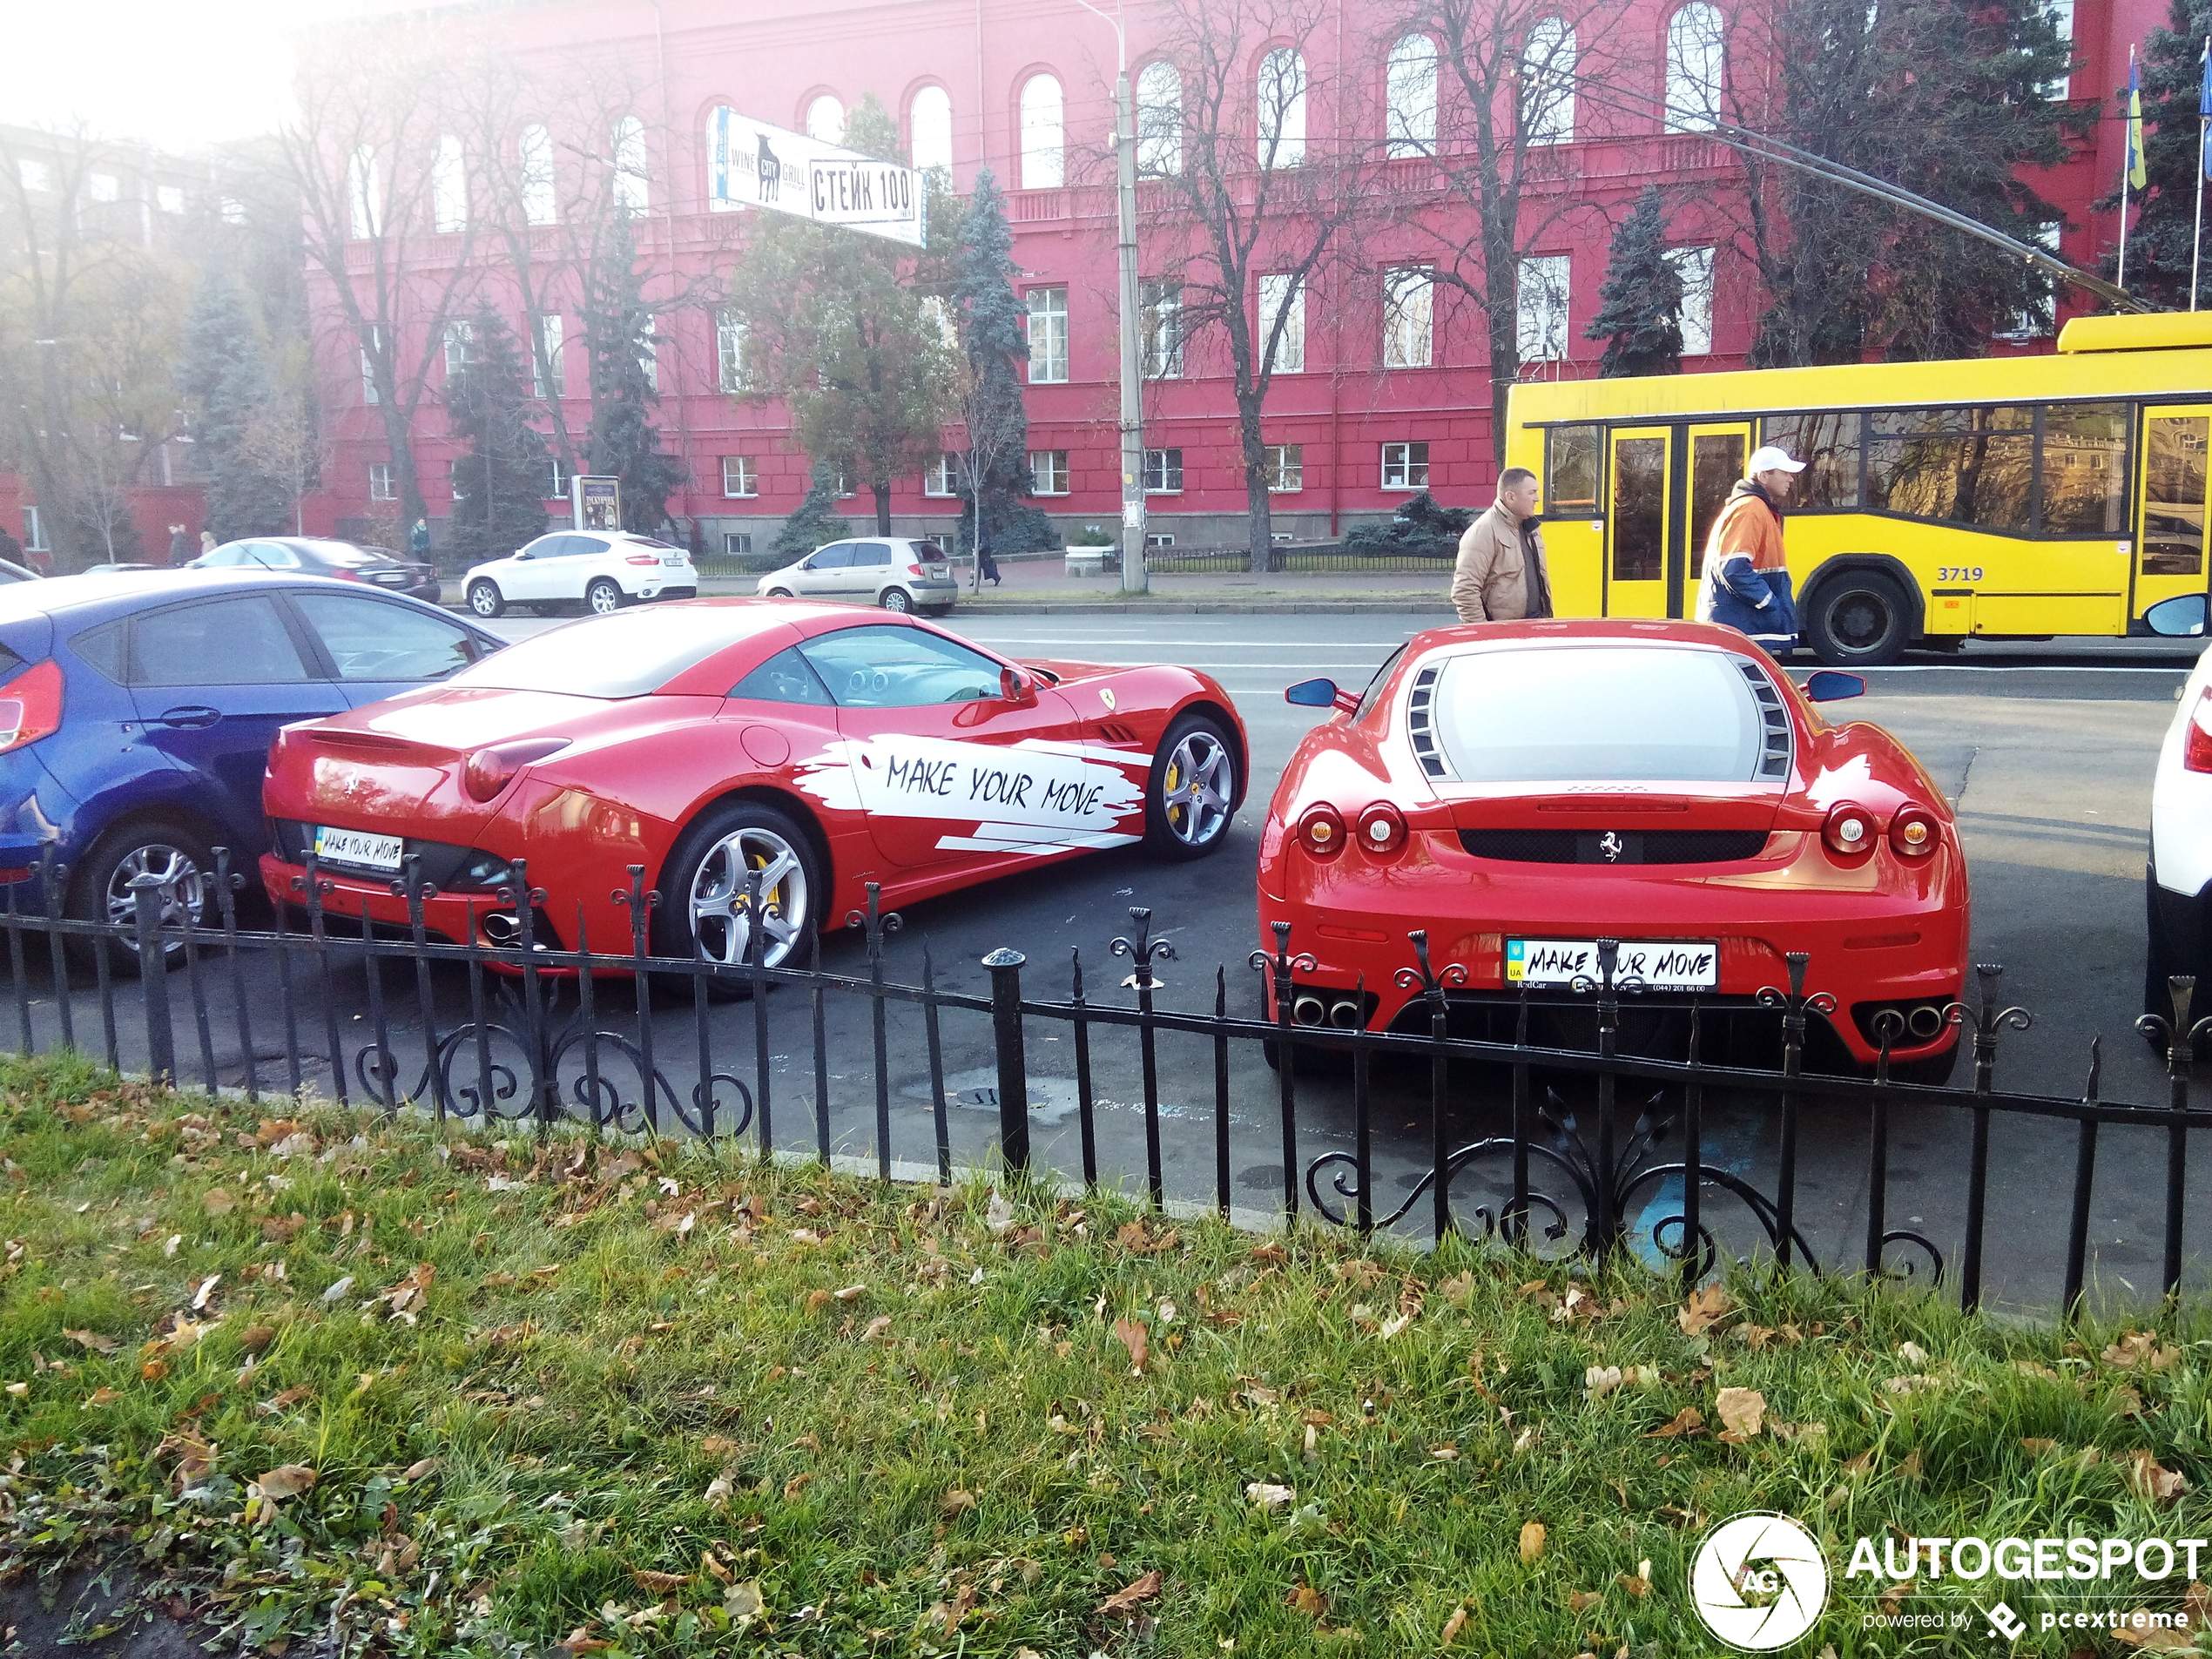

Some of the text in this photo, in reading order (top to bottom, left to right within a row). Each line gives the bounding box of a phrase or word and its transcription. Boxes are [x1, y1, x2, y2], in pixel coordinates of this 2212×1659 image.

[732, 148, 755, 172] WINE
[761, 158, 777, 179] CITY
[782, 163, 806, 185] GRILL
[813, 161, 909, 212] СТЕЙК 100
[1938, 567, 1983, 581] 3719
[887, 754, 1103, 815] MAKE YOUR MOVE
[323, 833, 401, 860] MAKE YOUR MOVE
[1527, 947, 1713, 979] MAKE YUR MOVE
